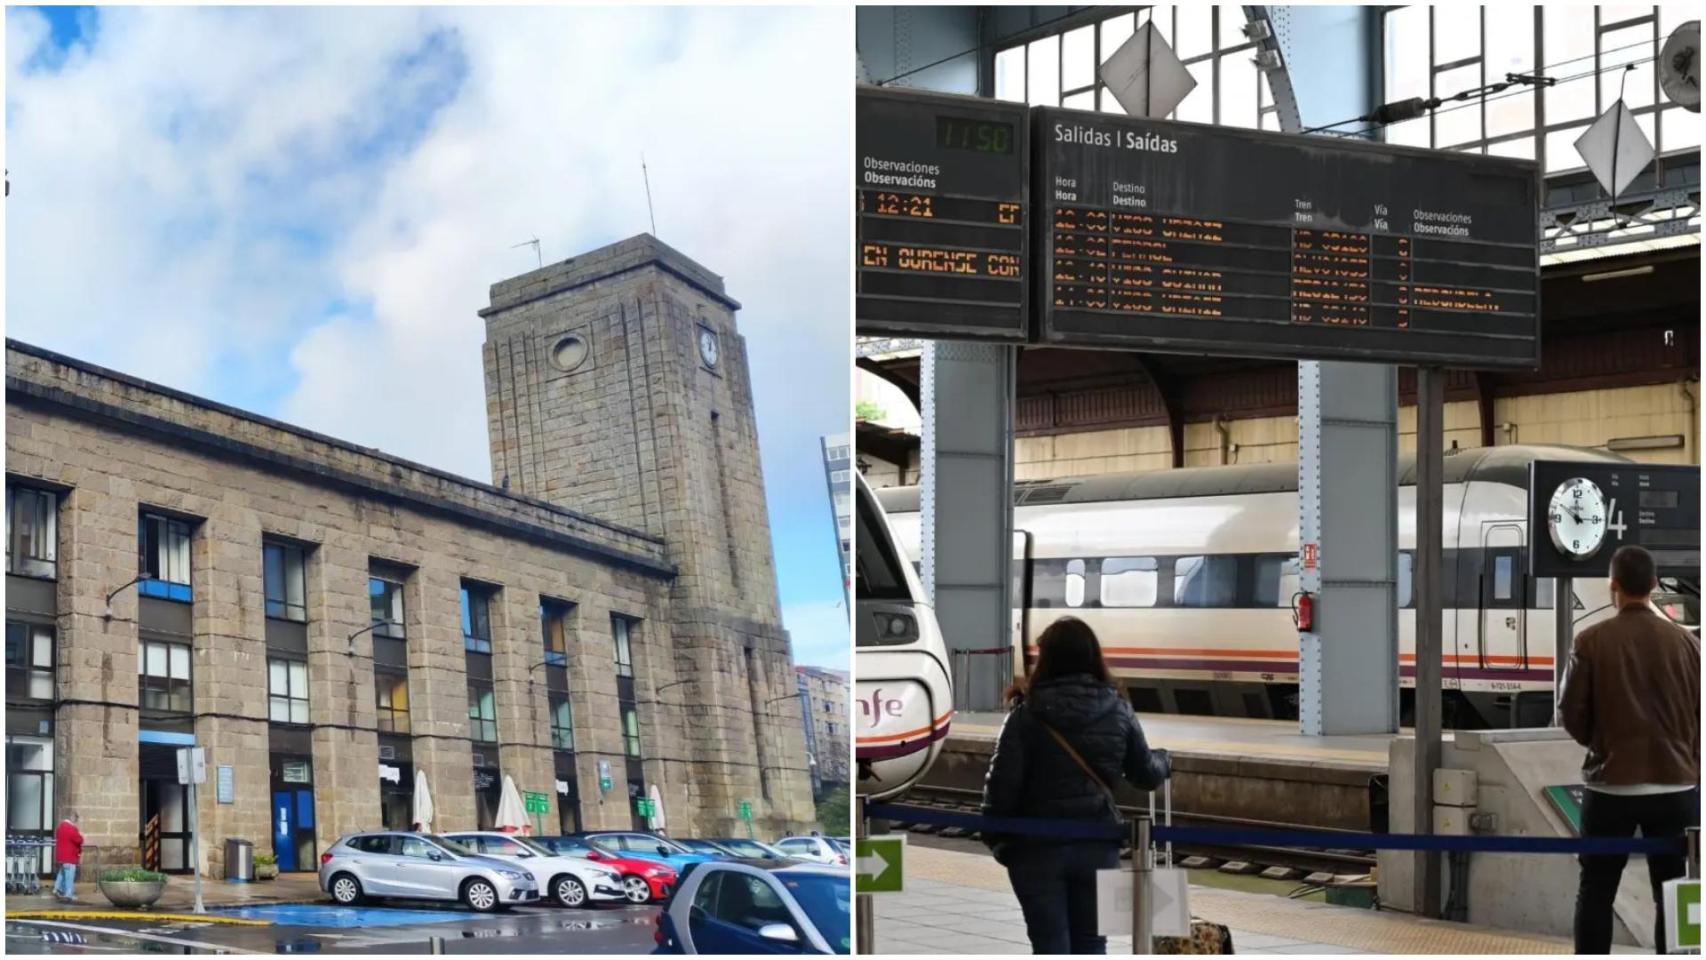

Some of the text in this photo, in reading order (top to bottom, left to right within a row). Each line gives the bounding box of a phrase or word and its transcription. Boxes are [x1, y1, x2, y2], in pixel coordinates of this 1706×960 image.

[1055, 124, 1111, 147] Salidas
[1126, 132, 1177, 153] Saídas
[864, 157, 940, 175] Observaciones
[864, 171, 936, 189] Observacións
[1055, 176, 1076, 188] Hora
[1113, 182, 1145, 194] Destino
[1055, 190, 1077, 201] Hora
[1113, 195, 1146, 207] Destino
[878, 193, 933, 217] 12:21
[1296, 199, 1312, 209] Tren
[1374, 204, 1387, 216] Vía
[1296, 213, 1313, 223] Tren
[1413, 209, 1472, 224] Observaciones
[1374, 219, 1388, 230] Vía
[1414, 222, 1470, 237] Observacións
[898, 248, 978, 273] OURENSE
[988, 254, 1020, 276] CON
[1573, 489, 1583, 499] 12
[1607, 498, 1627, 540] 4
[1572, 539, 1580, 549] 6
